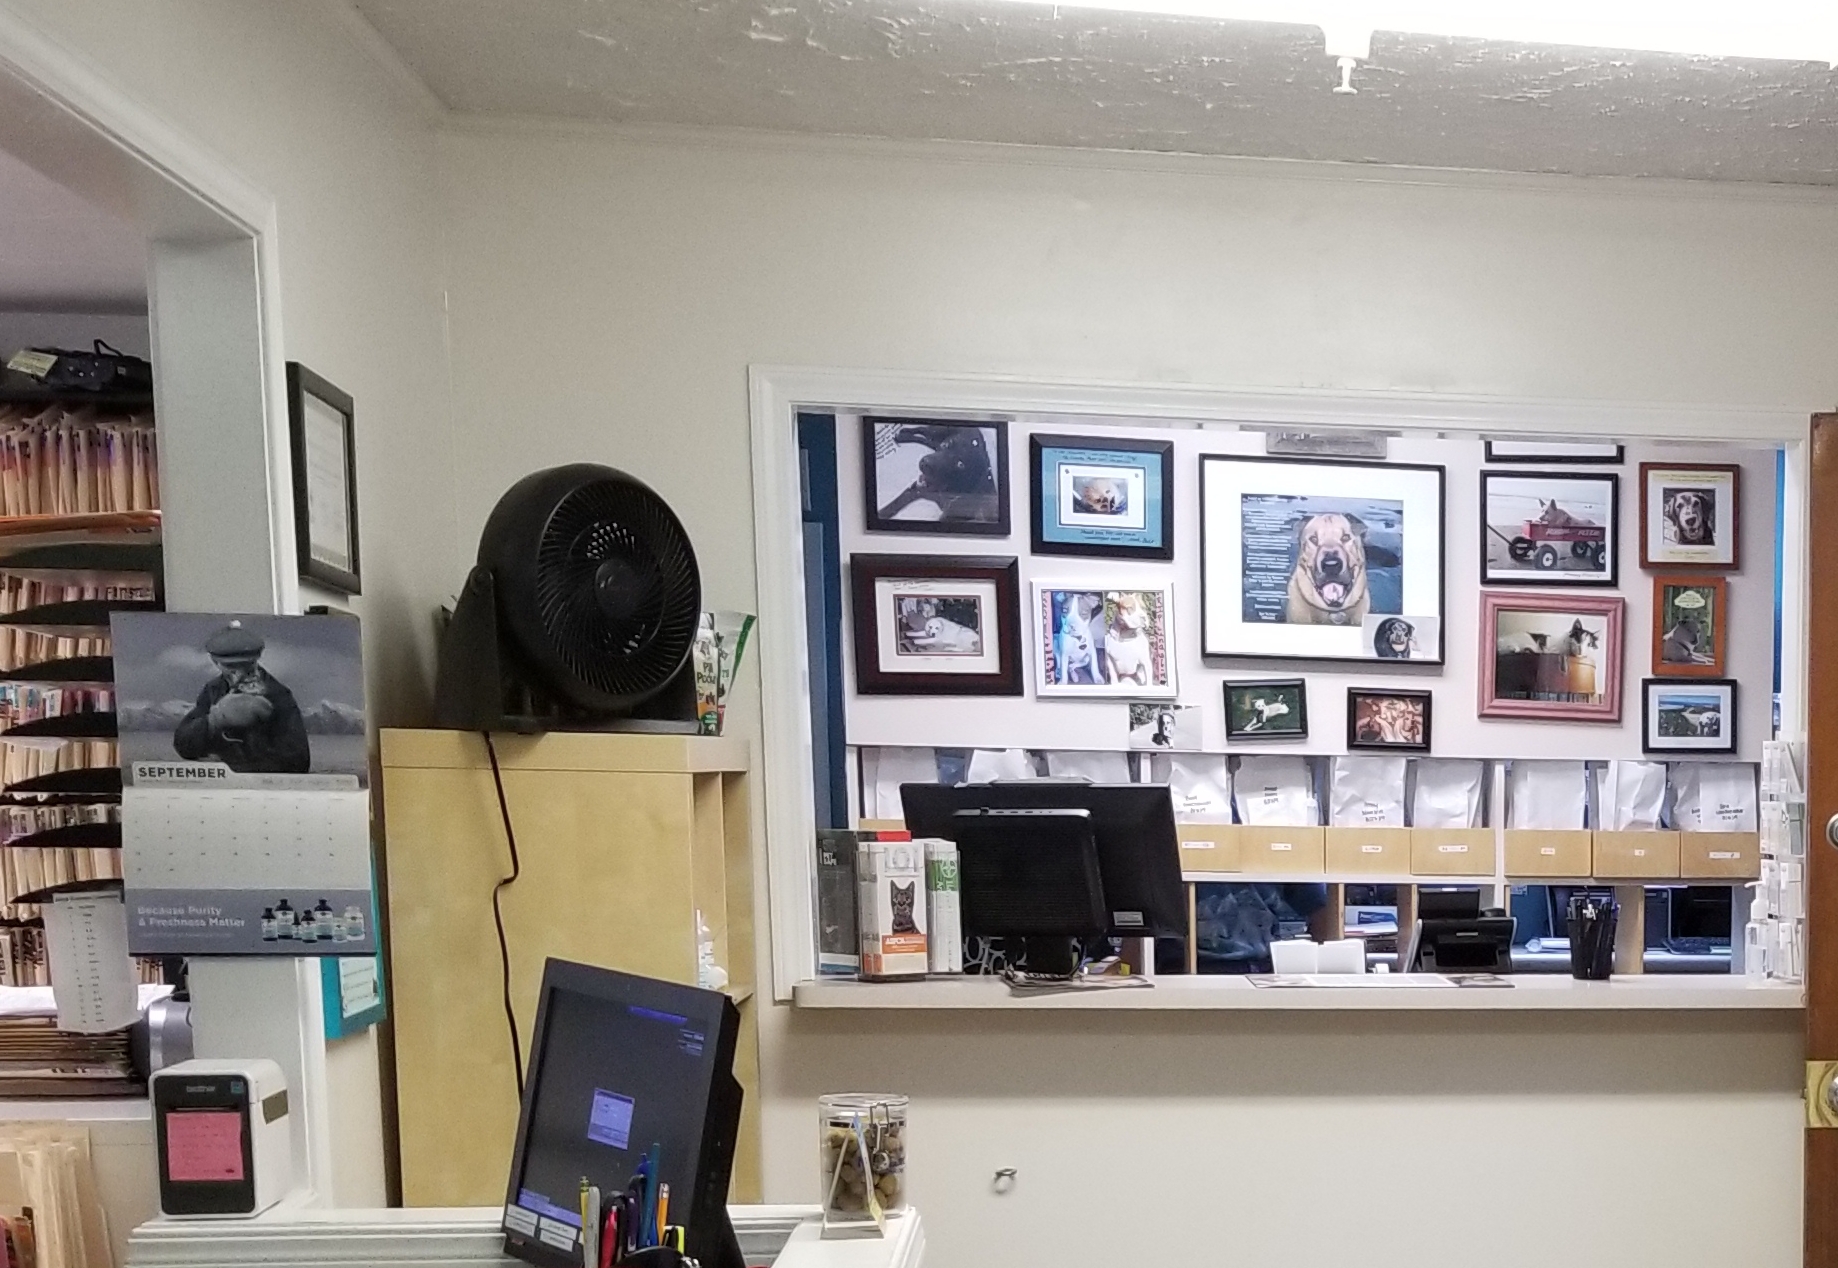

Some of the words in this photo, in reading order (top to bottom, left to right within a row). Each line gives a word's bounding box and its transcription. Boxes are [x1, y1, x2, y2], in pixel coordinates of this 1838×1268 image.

[138, 766, 227, 779] SEPTEMBER
[188, 905, 222, 918] Purity
[209, 916, 245, 928] Matter
